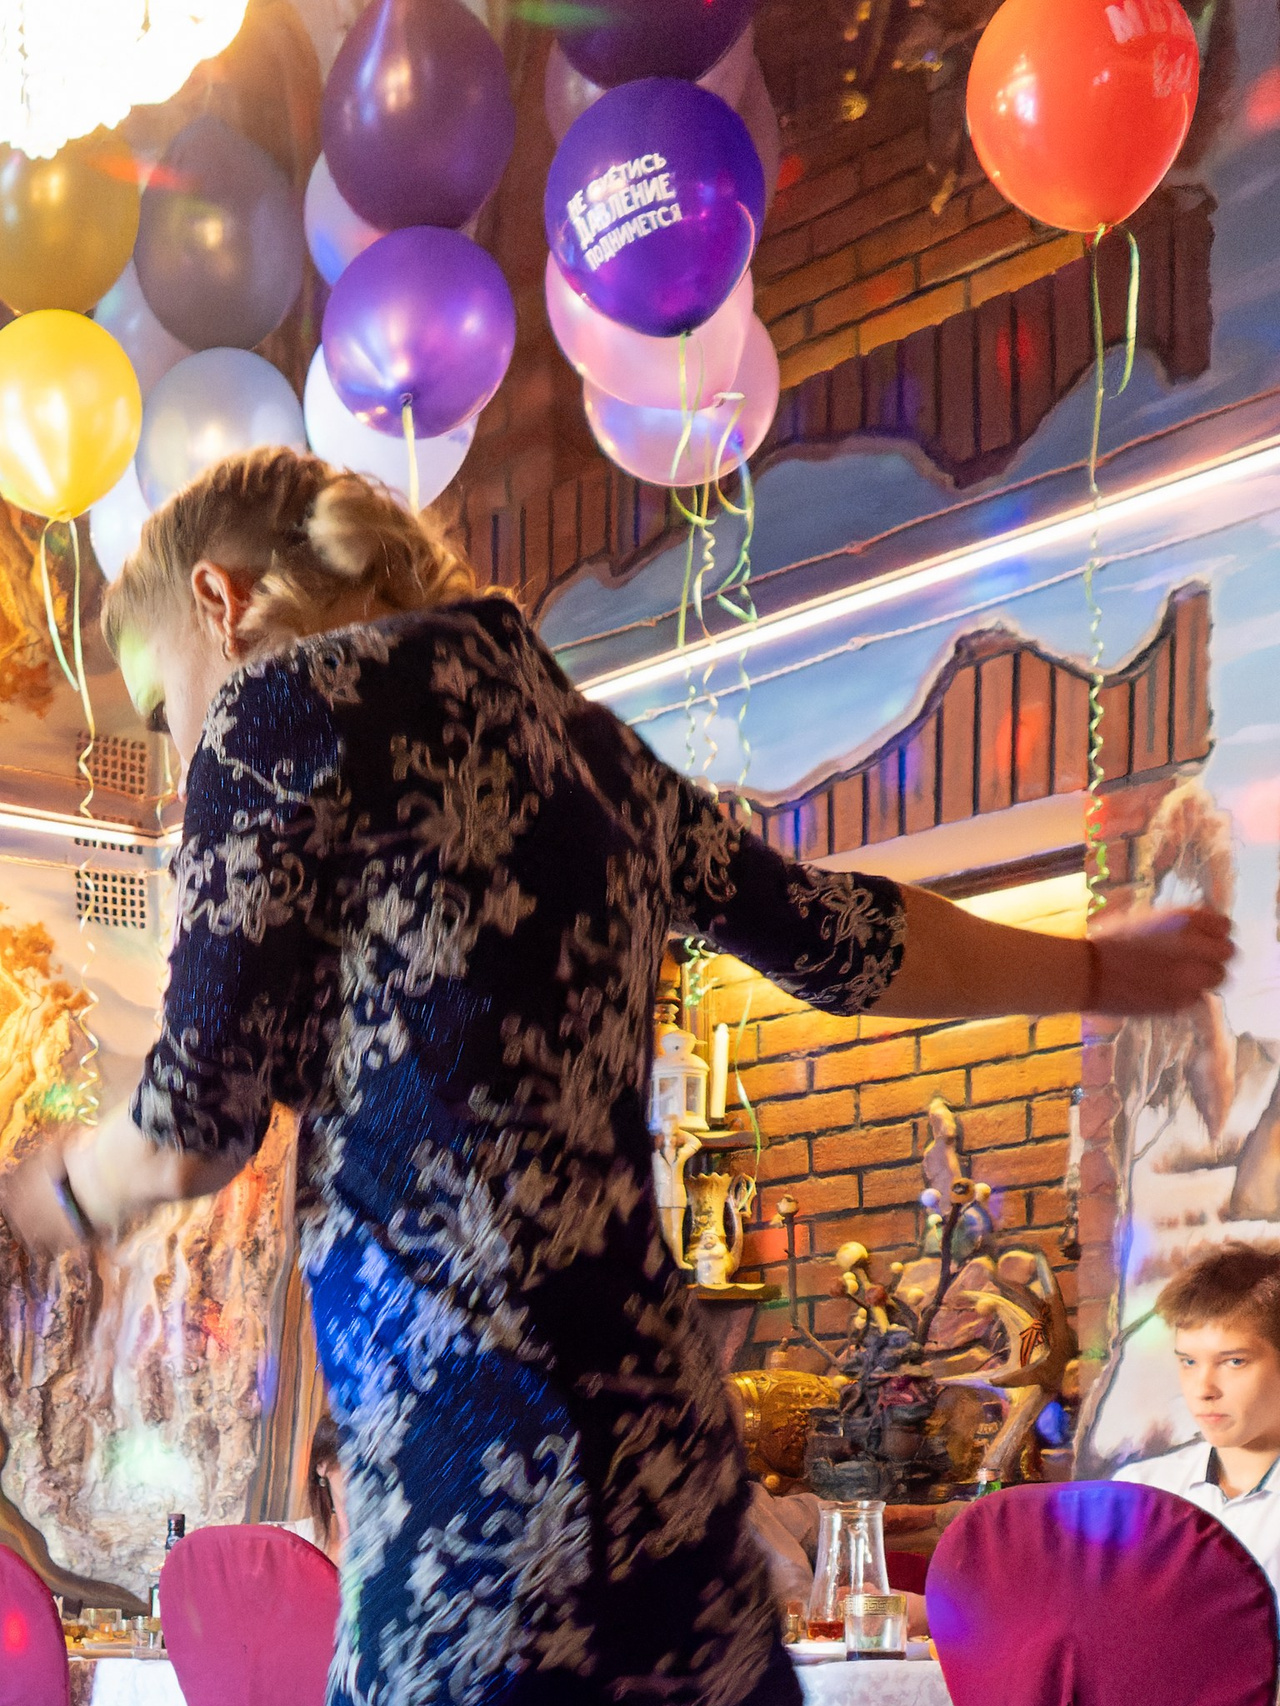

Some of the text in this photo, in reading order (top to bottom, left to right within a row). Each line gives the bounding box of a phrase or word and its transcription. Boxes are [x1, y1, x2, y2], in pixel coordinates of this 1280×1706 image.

[566, 190, 587, 223] НЕ
[573, 172, 677, 250] ДАВЛЕНИЕ
[584, 203, 682, 271] ПОДНИМЕТСЯ
